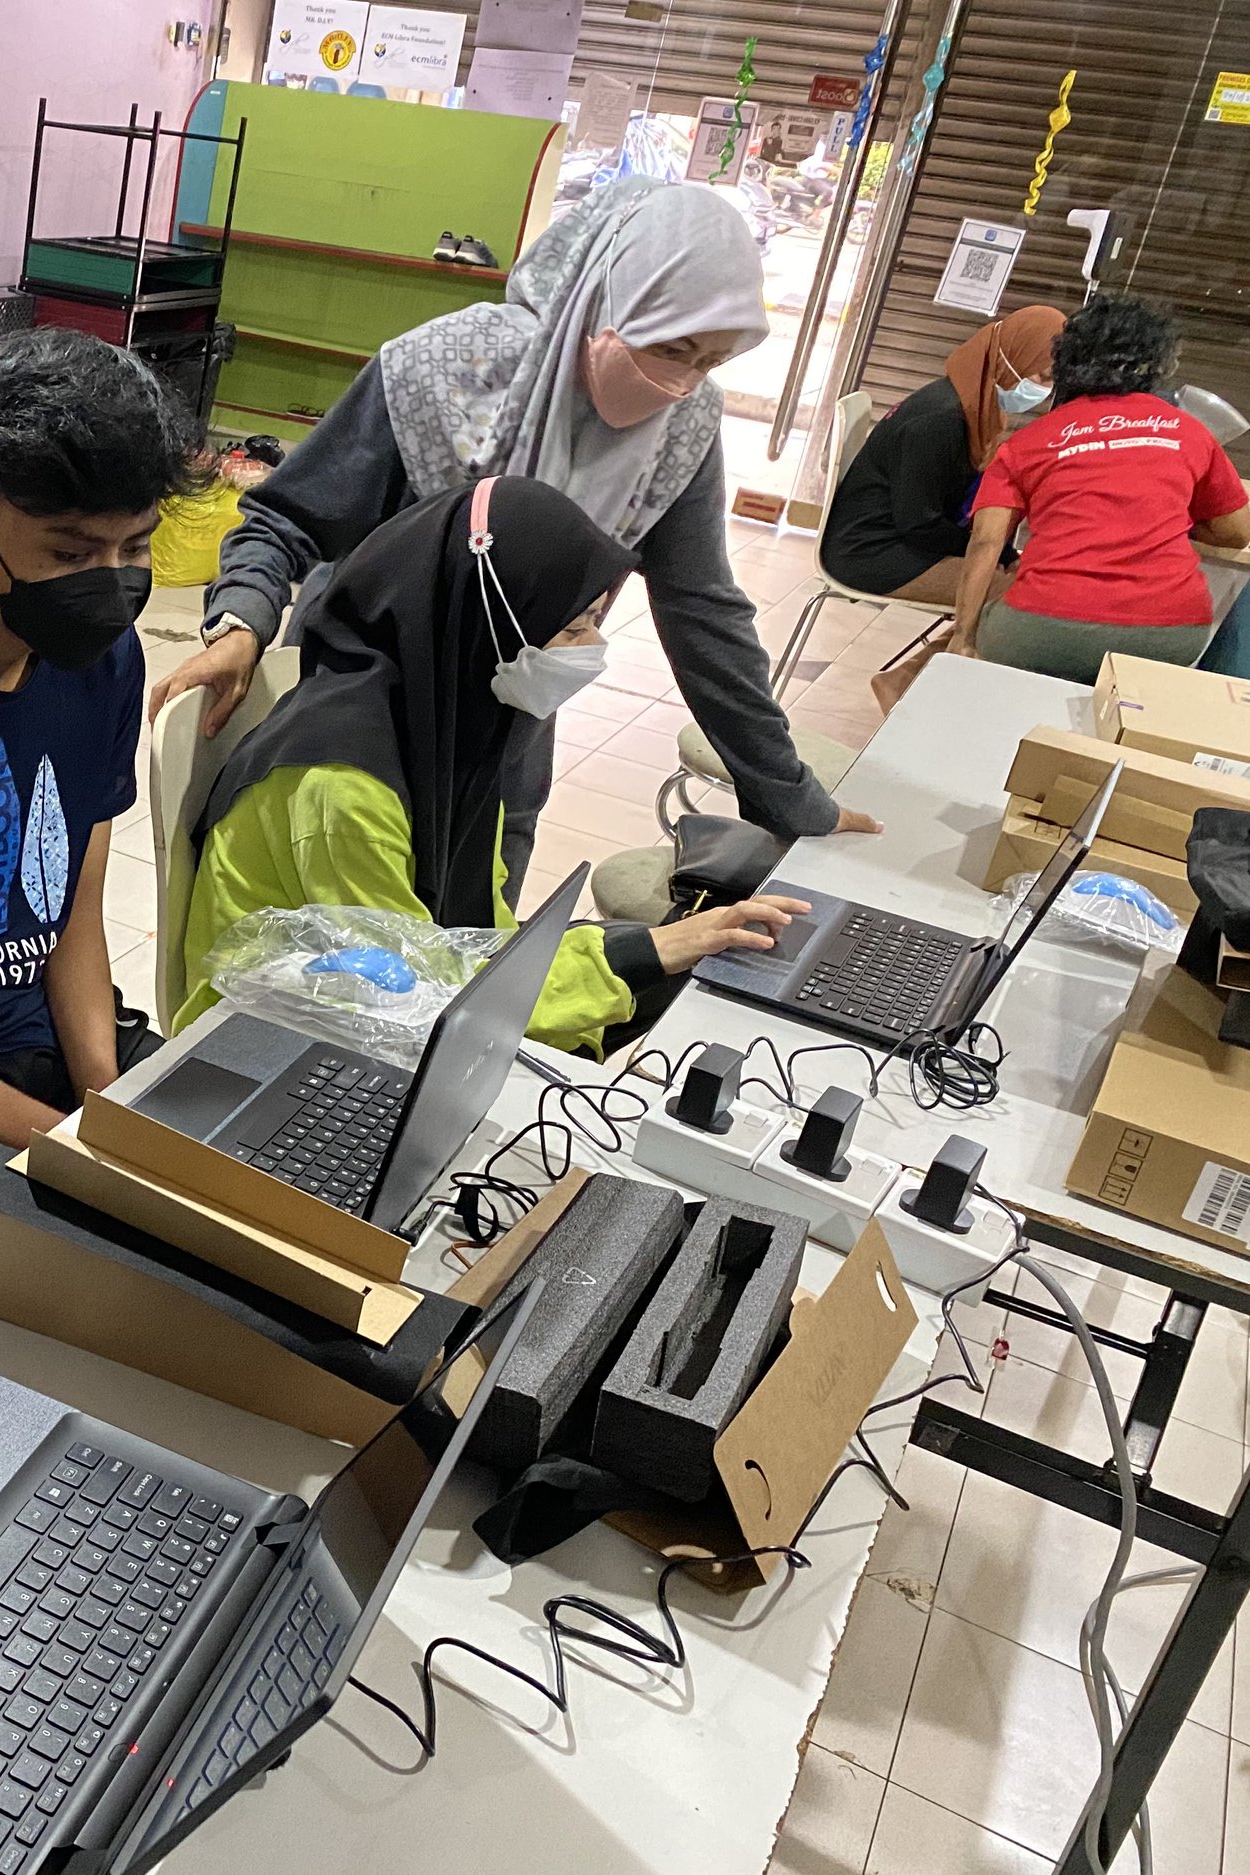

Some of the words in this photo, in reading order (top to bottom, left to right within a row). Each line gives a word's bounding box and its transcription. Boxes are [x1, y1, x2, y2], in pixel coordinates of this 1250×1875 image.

[411, 54, 448, 66] ecmlibra
[830, 117, 846, 153] PULL
[1098, 415, 1180, 432] Breakfast
[84, 1506, 95, 1514] Z
[122, 1510, 132, 1518] A
[155, 1519, 167, 1528] Q
[70, 1527, 79, 1535] X
[108, 1531, 118, 1539] S
[141, 1540, 153, 1549] W
[93, 1552, 103, 1560] D
[127, 1561, 138, 1570] E
[37, 1571, 47, 1579] V
[78, 1574, 87, 1582] F
[112, 1583, 123, 1591] R
[20, 1593, 30, 1601] B
[60, 1597, 70, 1605] G
[126, 1604, 135, 1612] 5
[2, 1616, 13, 1625] N
[43, 1620, 54, 1628] H
[80, 1631, 91, 1639] Y
[110, 1628, 119, 1636] 6
[26, 1645, 35, 1653] J
[63, 1654, 74, 1663] U
[95, 1652, 104, 1660] 7
[7, 1668, 19, 1677] K
[27, 1705, 38, 1714] O
[10, 1731, 20, 1741] P
